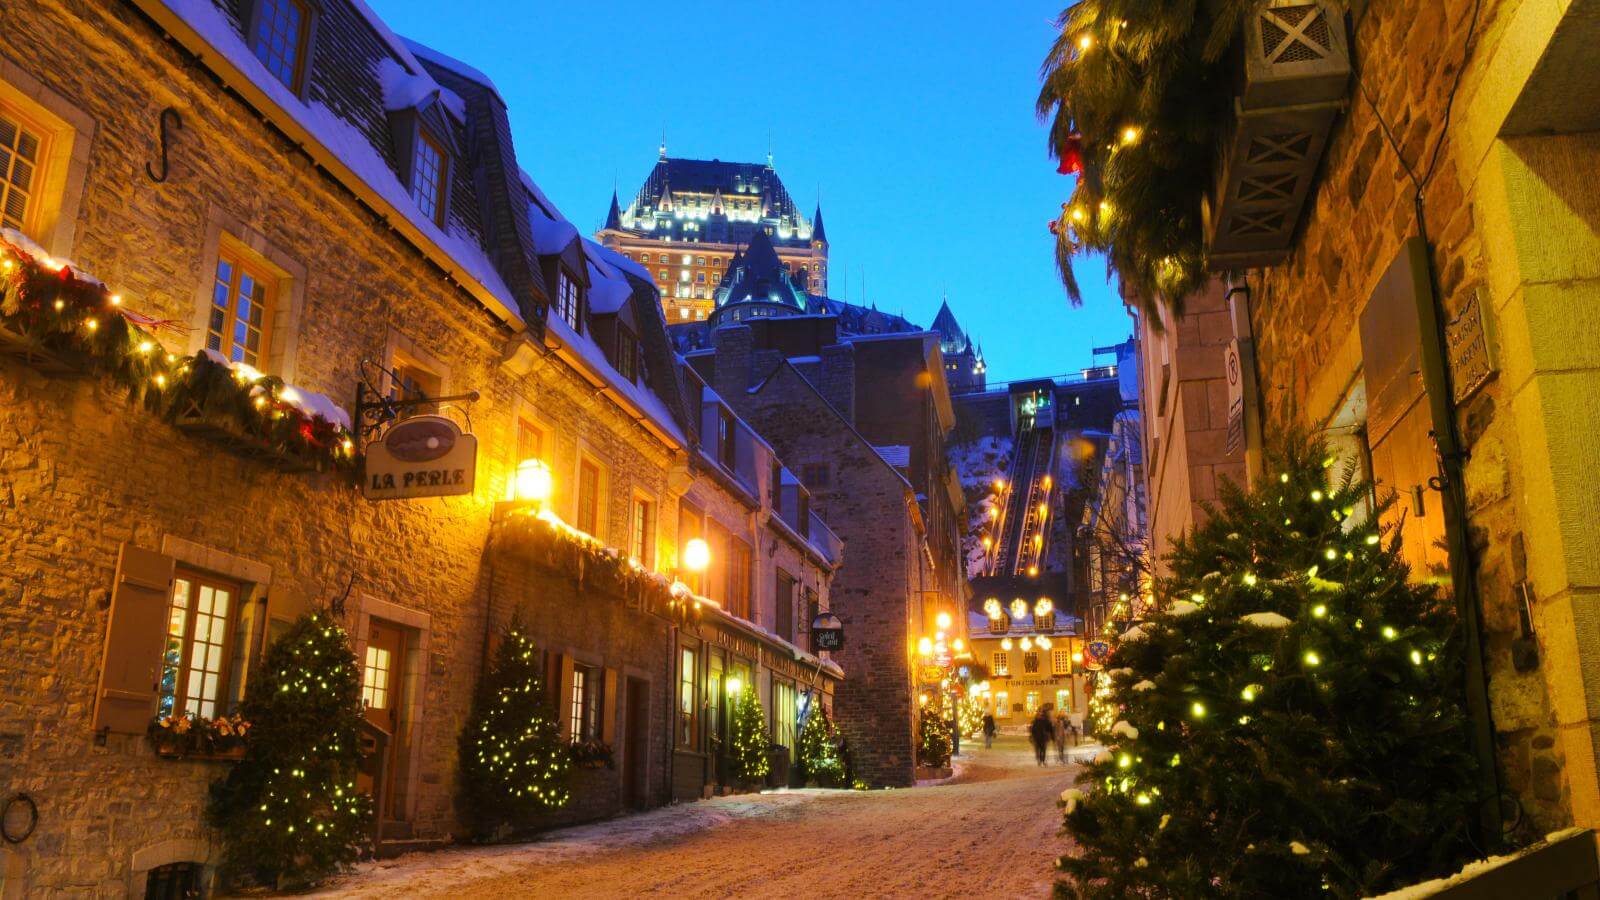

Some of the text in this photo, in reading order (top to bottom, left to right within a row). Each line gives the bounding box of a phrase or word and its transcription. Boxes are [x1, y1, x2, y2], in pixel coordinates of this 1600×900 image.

[371, 469, 465, 490] LA PERLE
[1005, 678, 1058, 687] FUNICULAIRE
